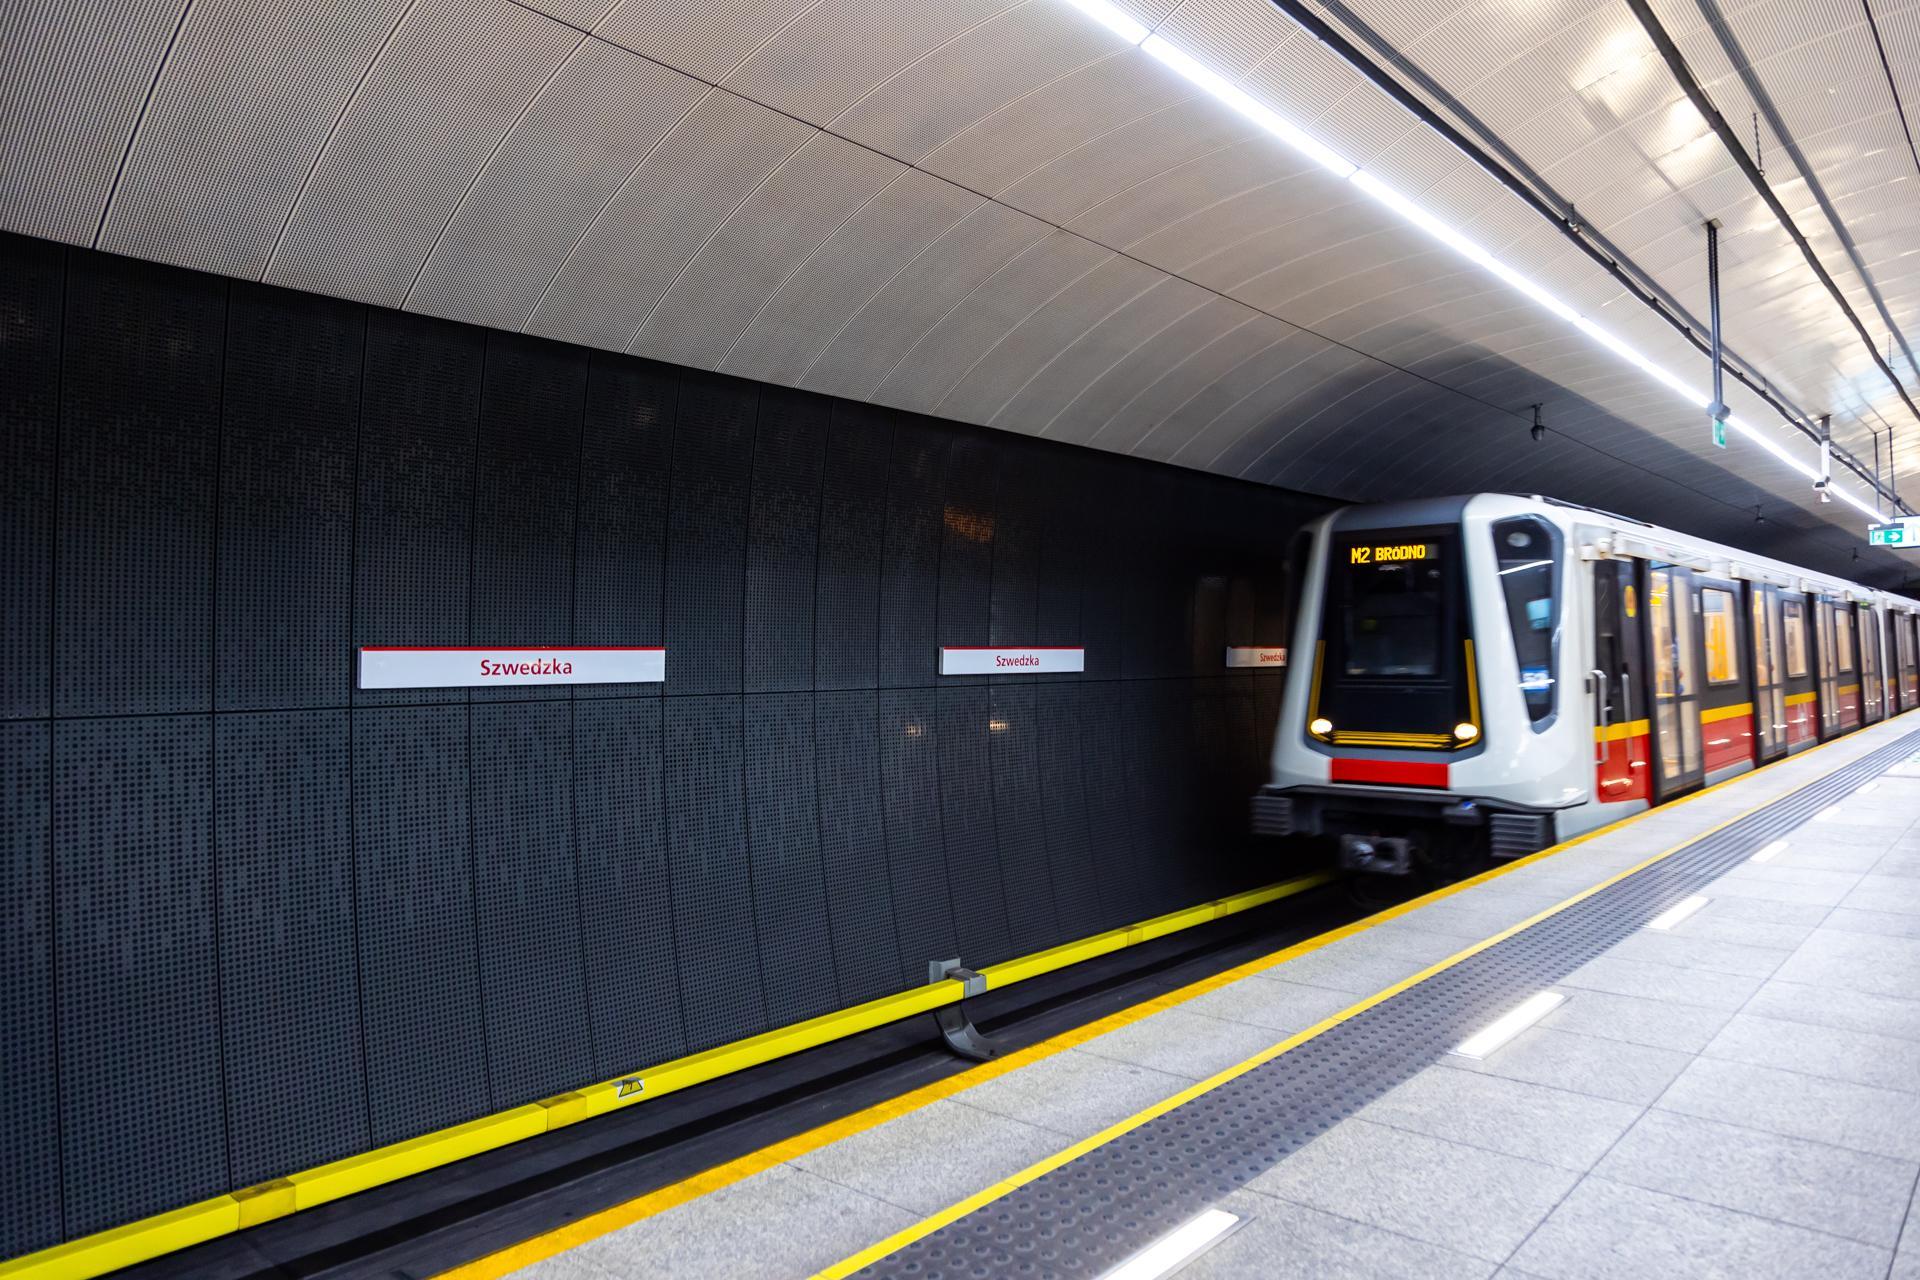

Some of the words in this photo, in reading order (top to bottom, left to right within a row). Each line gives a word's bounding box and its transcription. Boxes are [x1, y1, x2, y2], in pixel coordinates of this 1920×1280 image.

[1351, 547, 1370, 564] M2
[480, 658, 572, 676] Szwedzka
[996, 654, 1040, 667] Szwedzka
